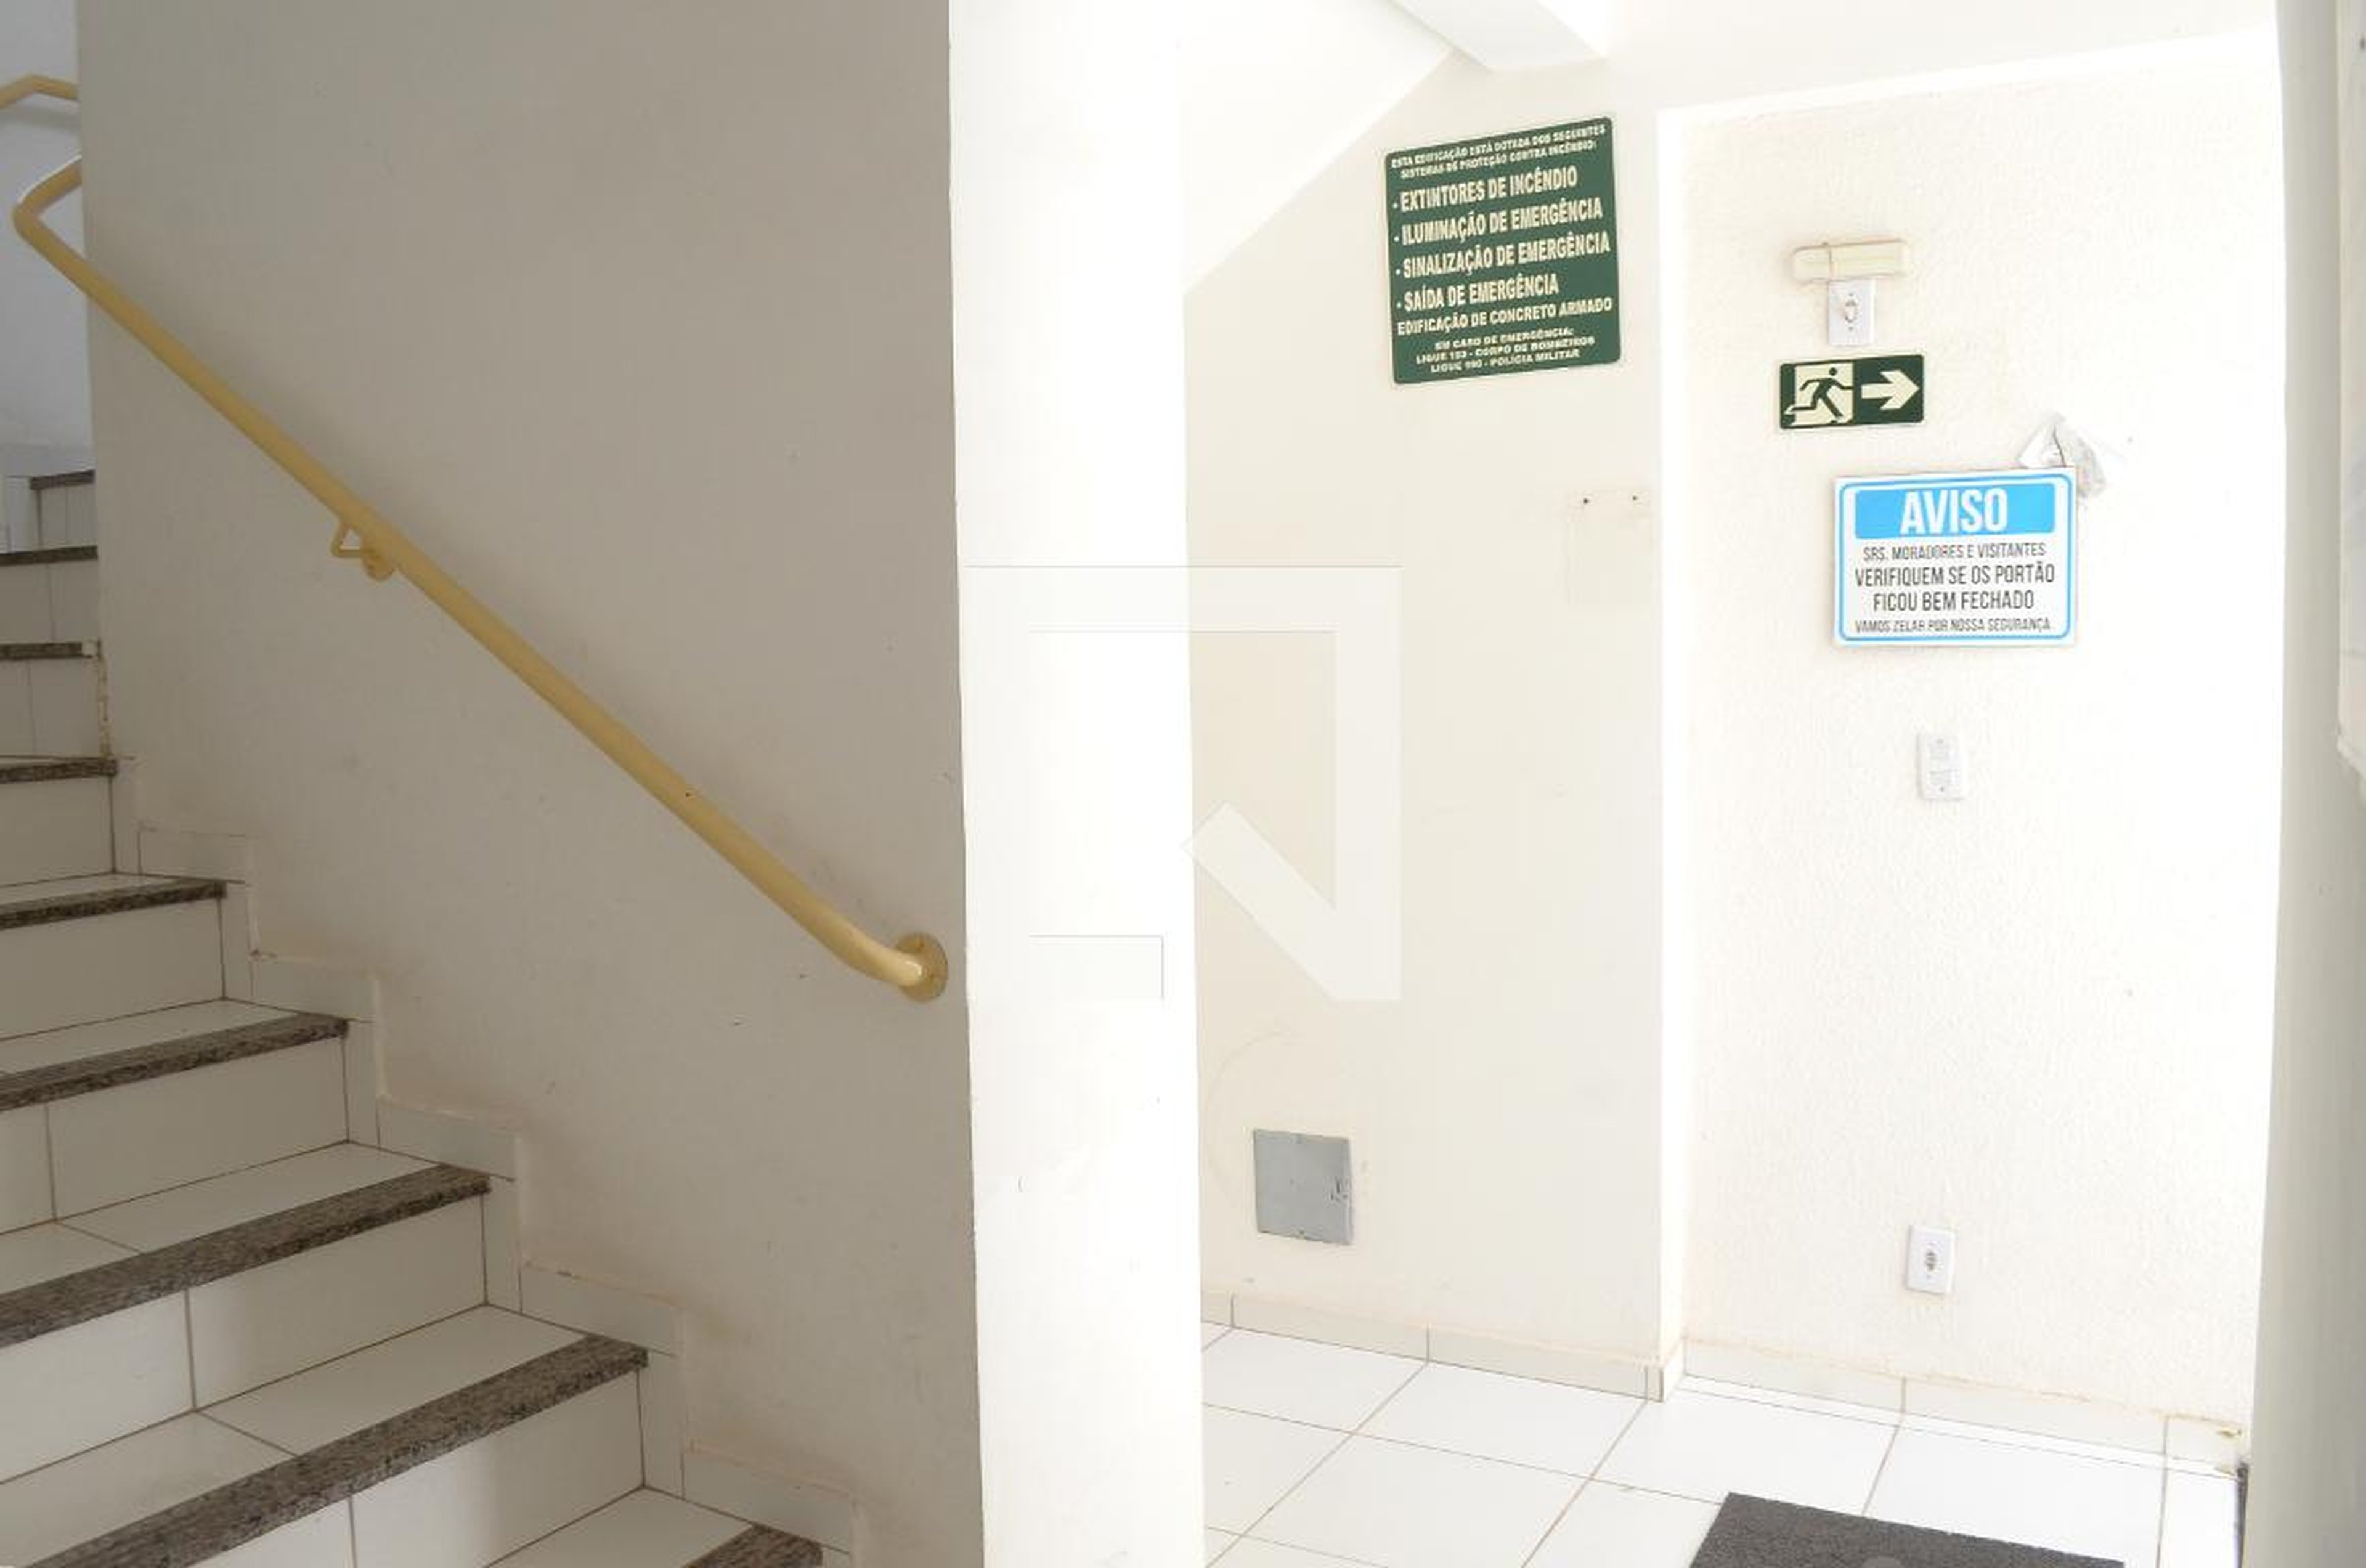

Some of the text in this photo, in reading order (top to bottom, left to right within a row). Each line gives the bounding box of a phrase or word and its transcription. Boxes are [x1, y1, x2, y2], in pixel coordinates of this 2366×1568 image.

[1532, 134, 1551, 145] DOS
[1446, 162, 1458, 171] DE
[1400, 165, 1577, 212] EXTINTORES DE INCÊNDIO
[1402, 197, 1603, 245] ILUMINAÇÃO DE EMERGÊNCIA
[1404, 231, 1611, 278] SINALIZAÇÃO DE EMERGÊNCIA
[1404, 273, 1559, 311] SAÍDA DE EMERGÊNCIA
[1397, 297, 1612, 335] EDIFICAÇÃO DE CONCRETO ARMADO
[1484, 335, 1498, 344] DE
[1514, 344, 1527, 352] DE
[1900, 487, 2008, 534] AVISO
[1864, 542, 2046, 561] SRS. MORADORES E VISITANTES
[1855, 561, 2054, 587] VERIFIQUEM SE OS PORTÃO
[1873, 590, 2034, 611] FICOU BEM FECHADO
[1855, 619, 1891, 633] VAMOS
[1929, 619, 1948, 632] POR
[1951, 618, 1985, 632] NOSSA
[1988, 617, 2051, 633] SEGURANÇA
